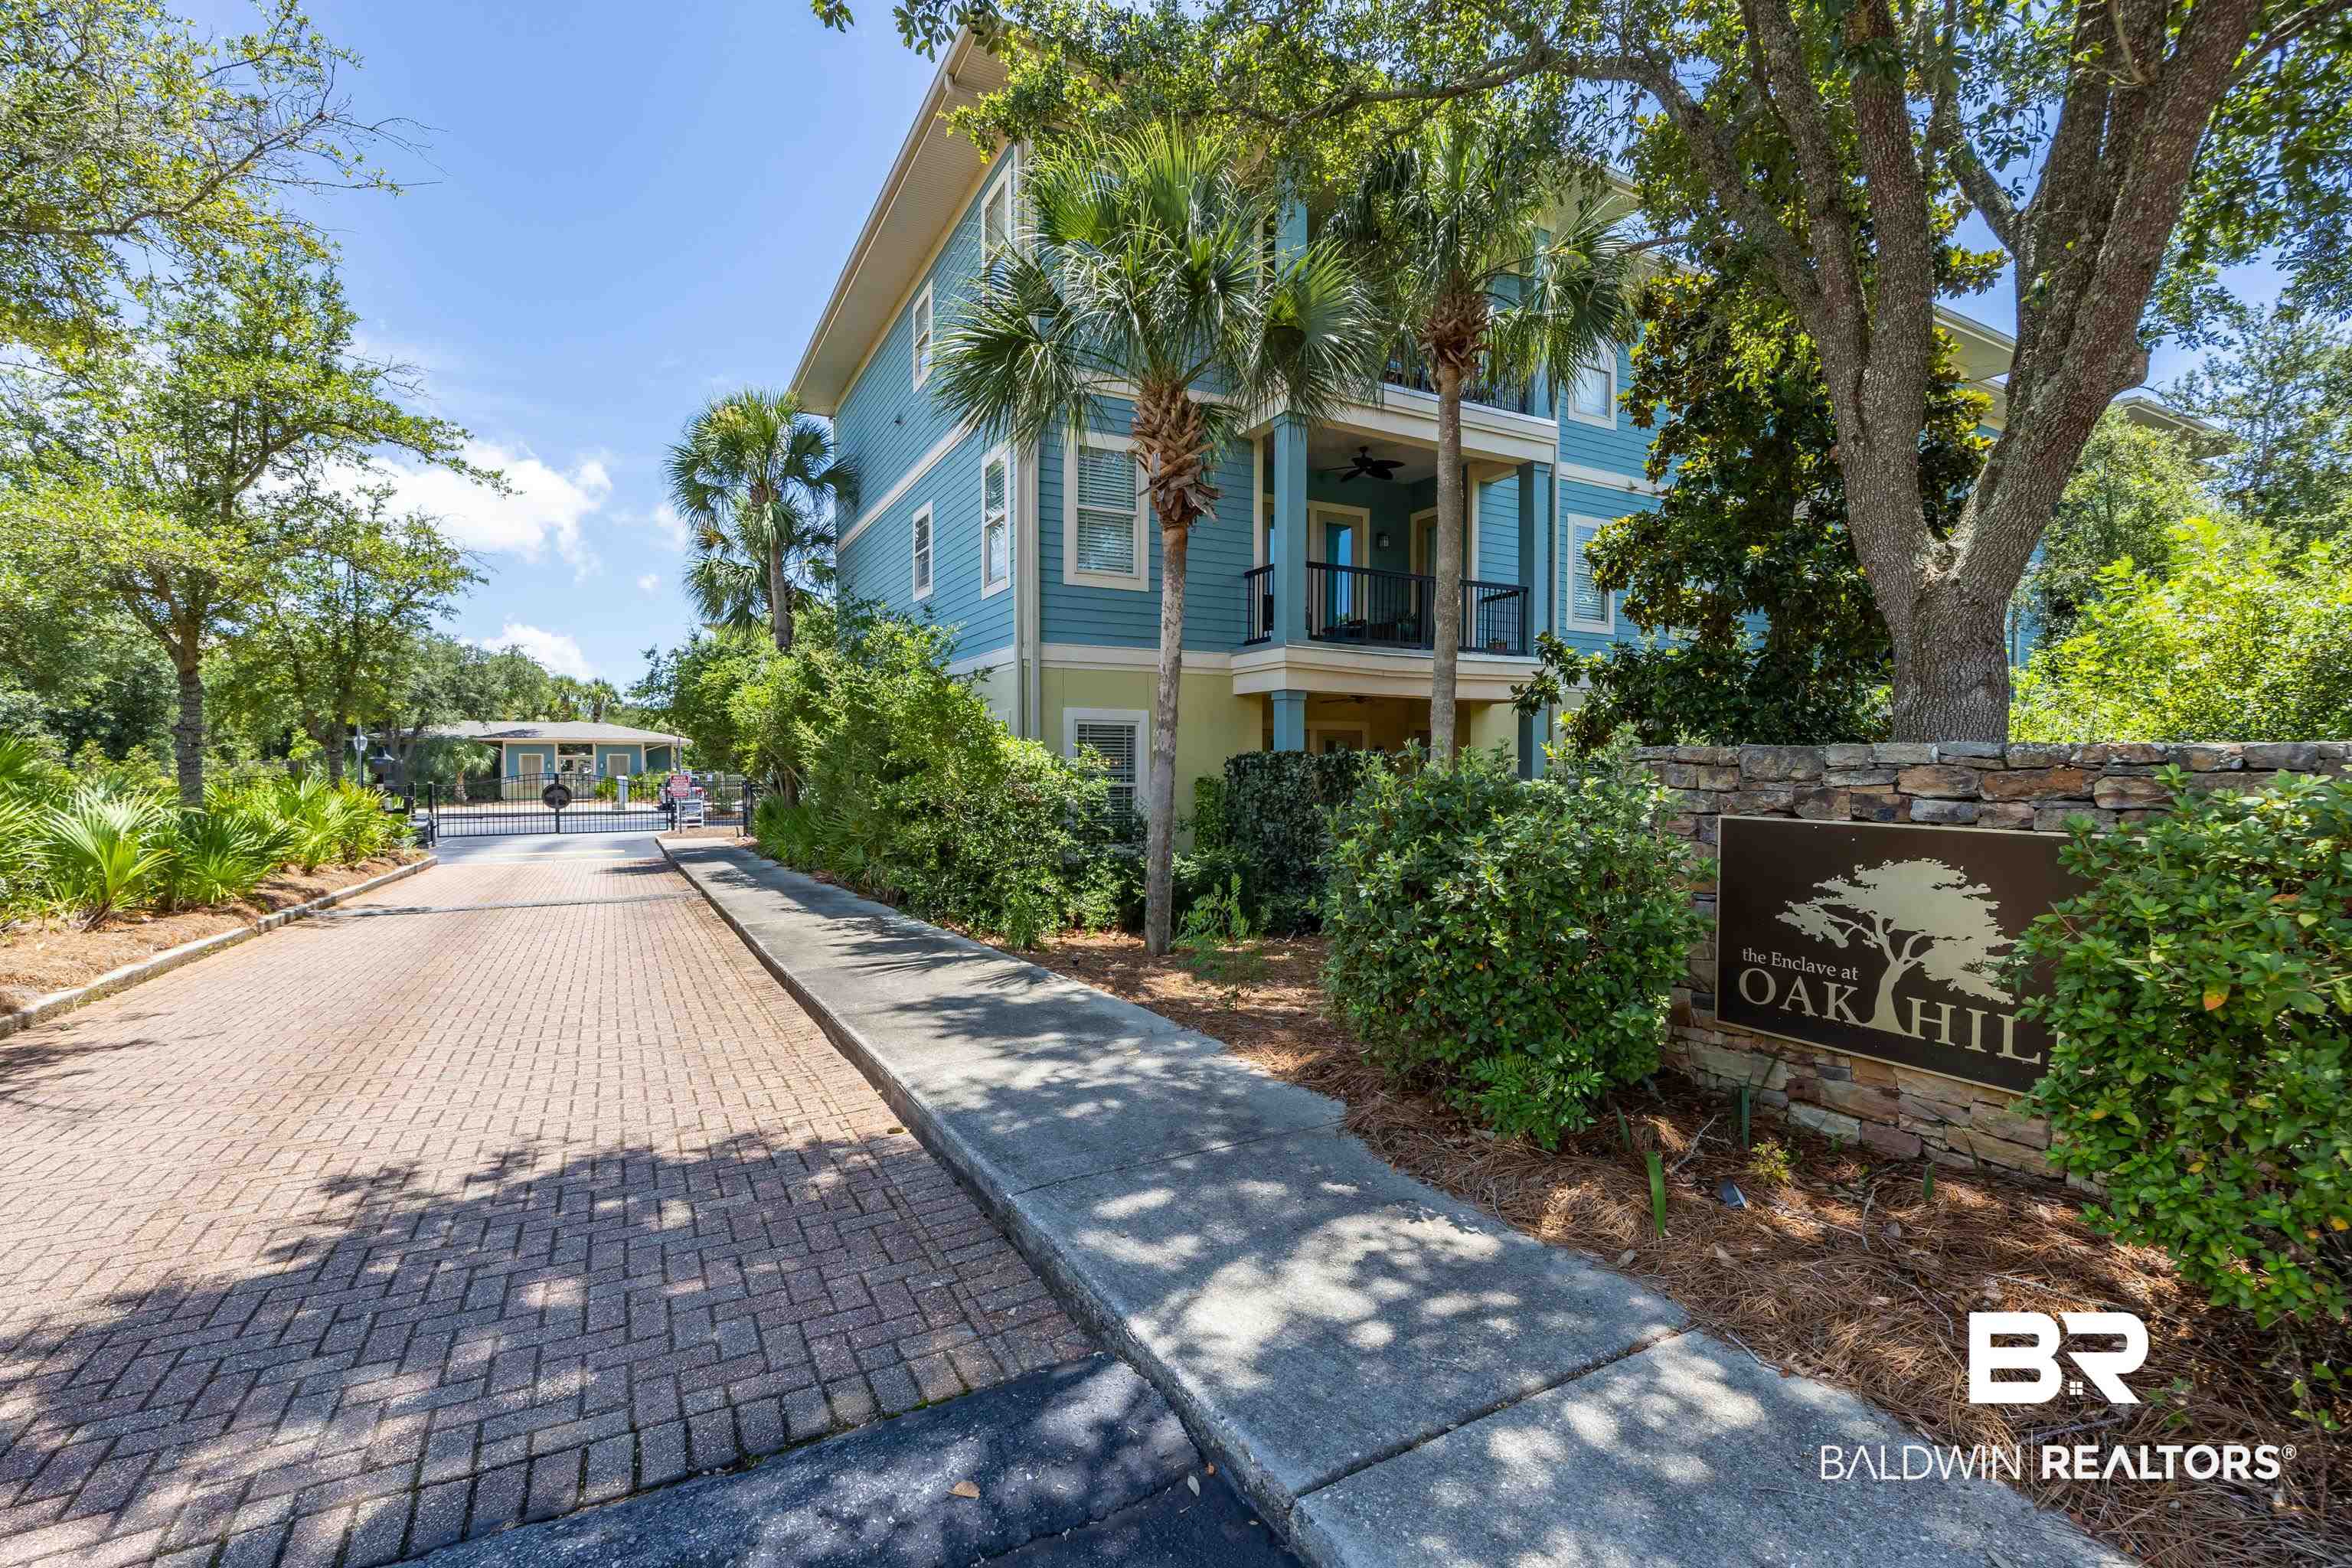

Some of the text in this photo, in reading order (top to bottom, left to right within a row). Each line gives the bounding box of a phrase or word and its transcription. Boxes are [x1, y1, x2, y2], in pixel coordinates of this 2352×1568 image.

[1743, 948, 1859, 981] the Enclave at
[1739, 968, 2096, 1076] OAK HIL
